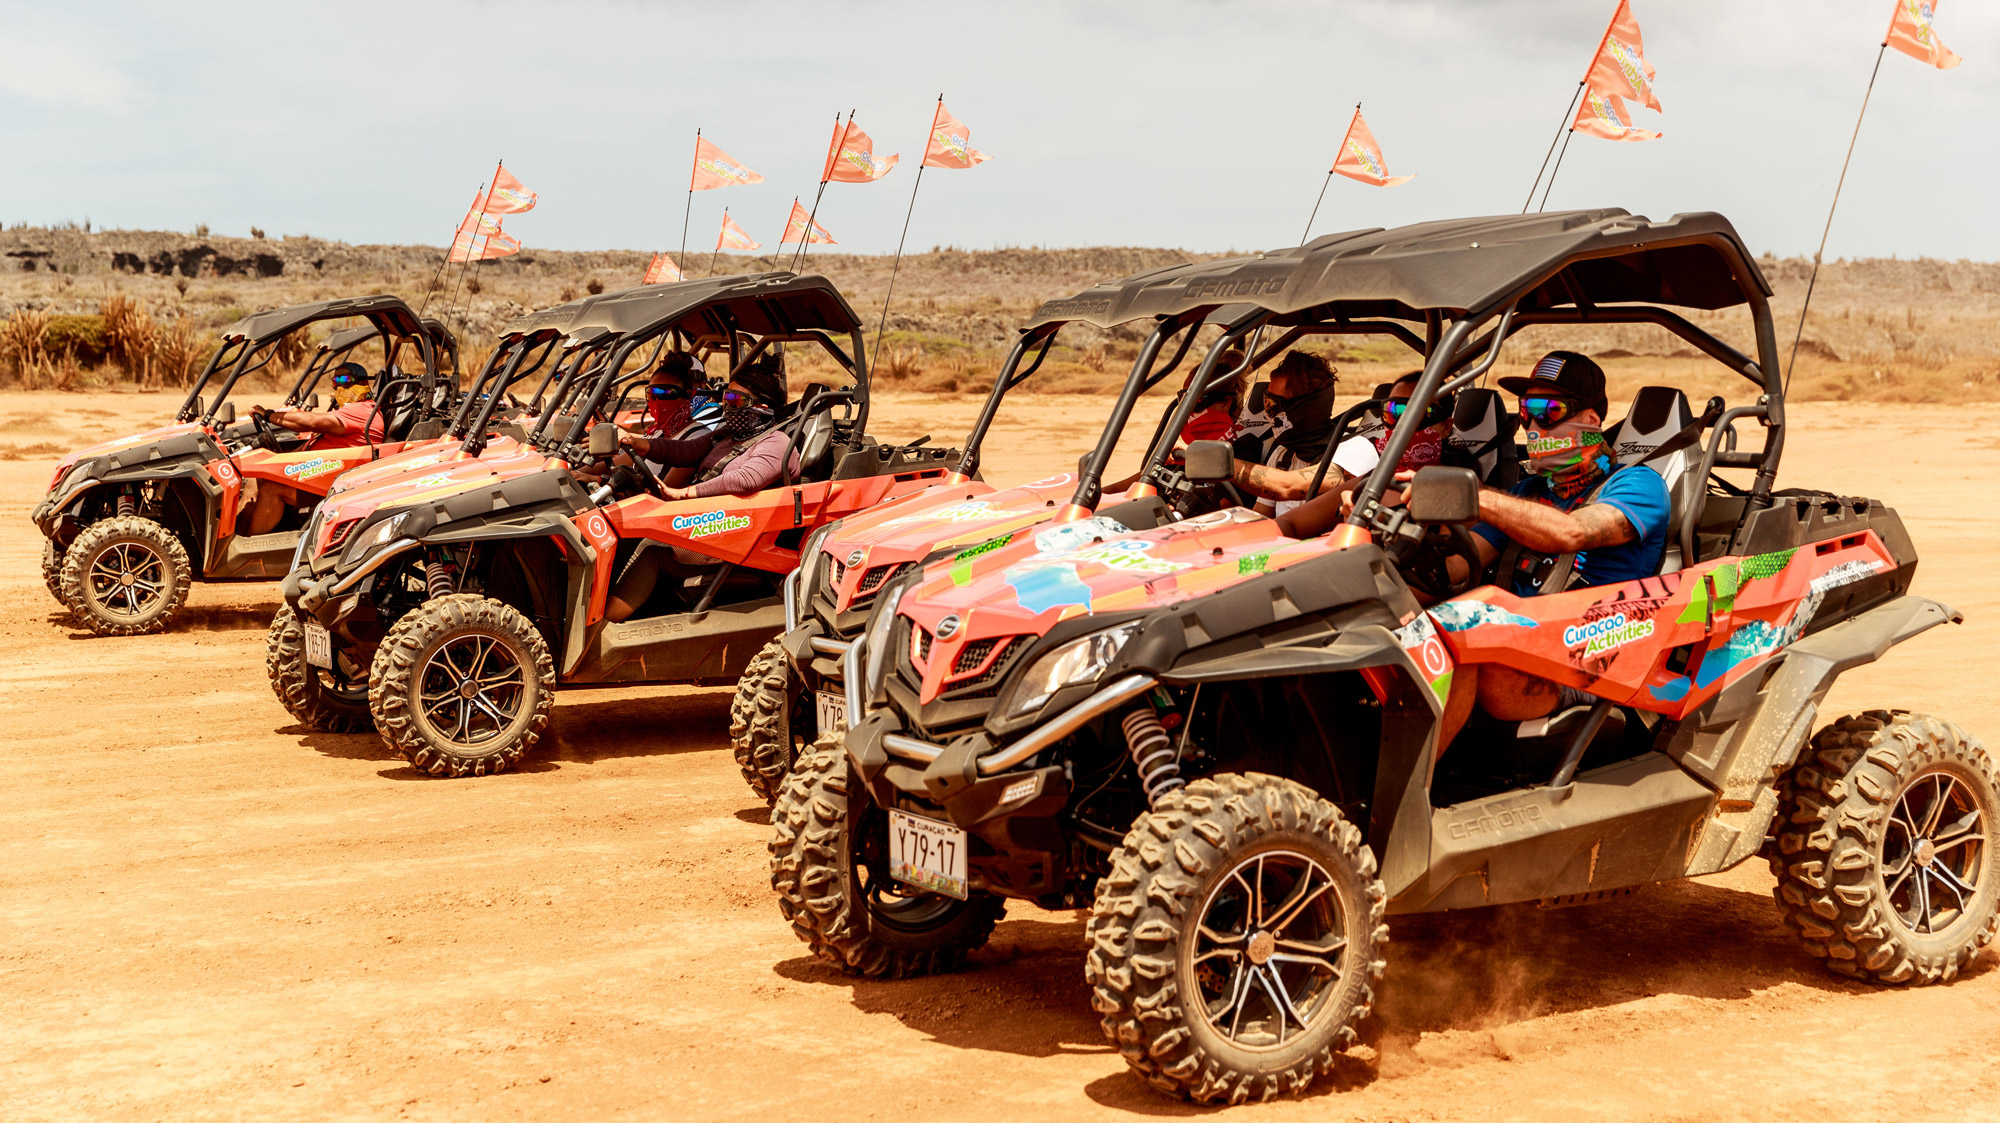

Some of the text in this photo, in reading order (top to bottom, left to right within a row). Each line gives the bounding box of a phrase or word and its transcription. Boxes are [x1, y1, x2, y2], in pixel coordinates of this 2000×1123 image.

[1183, 278, 1289, 298] CFMOTO
[1528, 437, 1571, 454] ivities
[285, 458, 323, 475] Curaçao
[299, 460, 342, 480] Activities
[673, 510, 725, 530] Curaçao
[690, 516, 749, 538] Activities
[616, 623, 684, 640] CFMOTO
[1564, 614, 1625, 646] Curaçao
[1586, 620, 1653, 655] Activities
[1428, 647, 1440, 664] 1
[916, 822, 946, 837] CURAÇAO
[1447, 804, 1543, 840] CFMOTO
[898, 827, 956, 877] Y79-17
